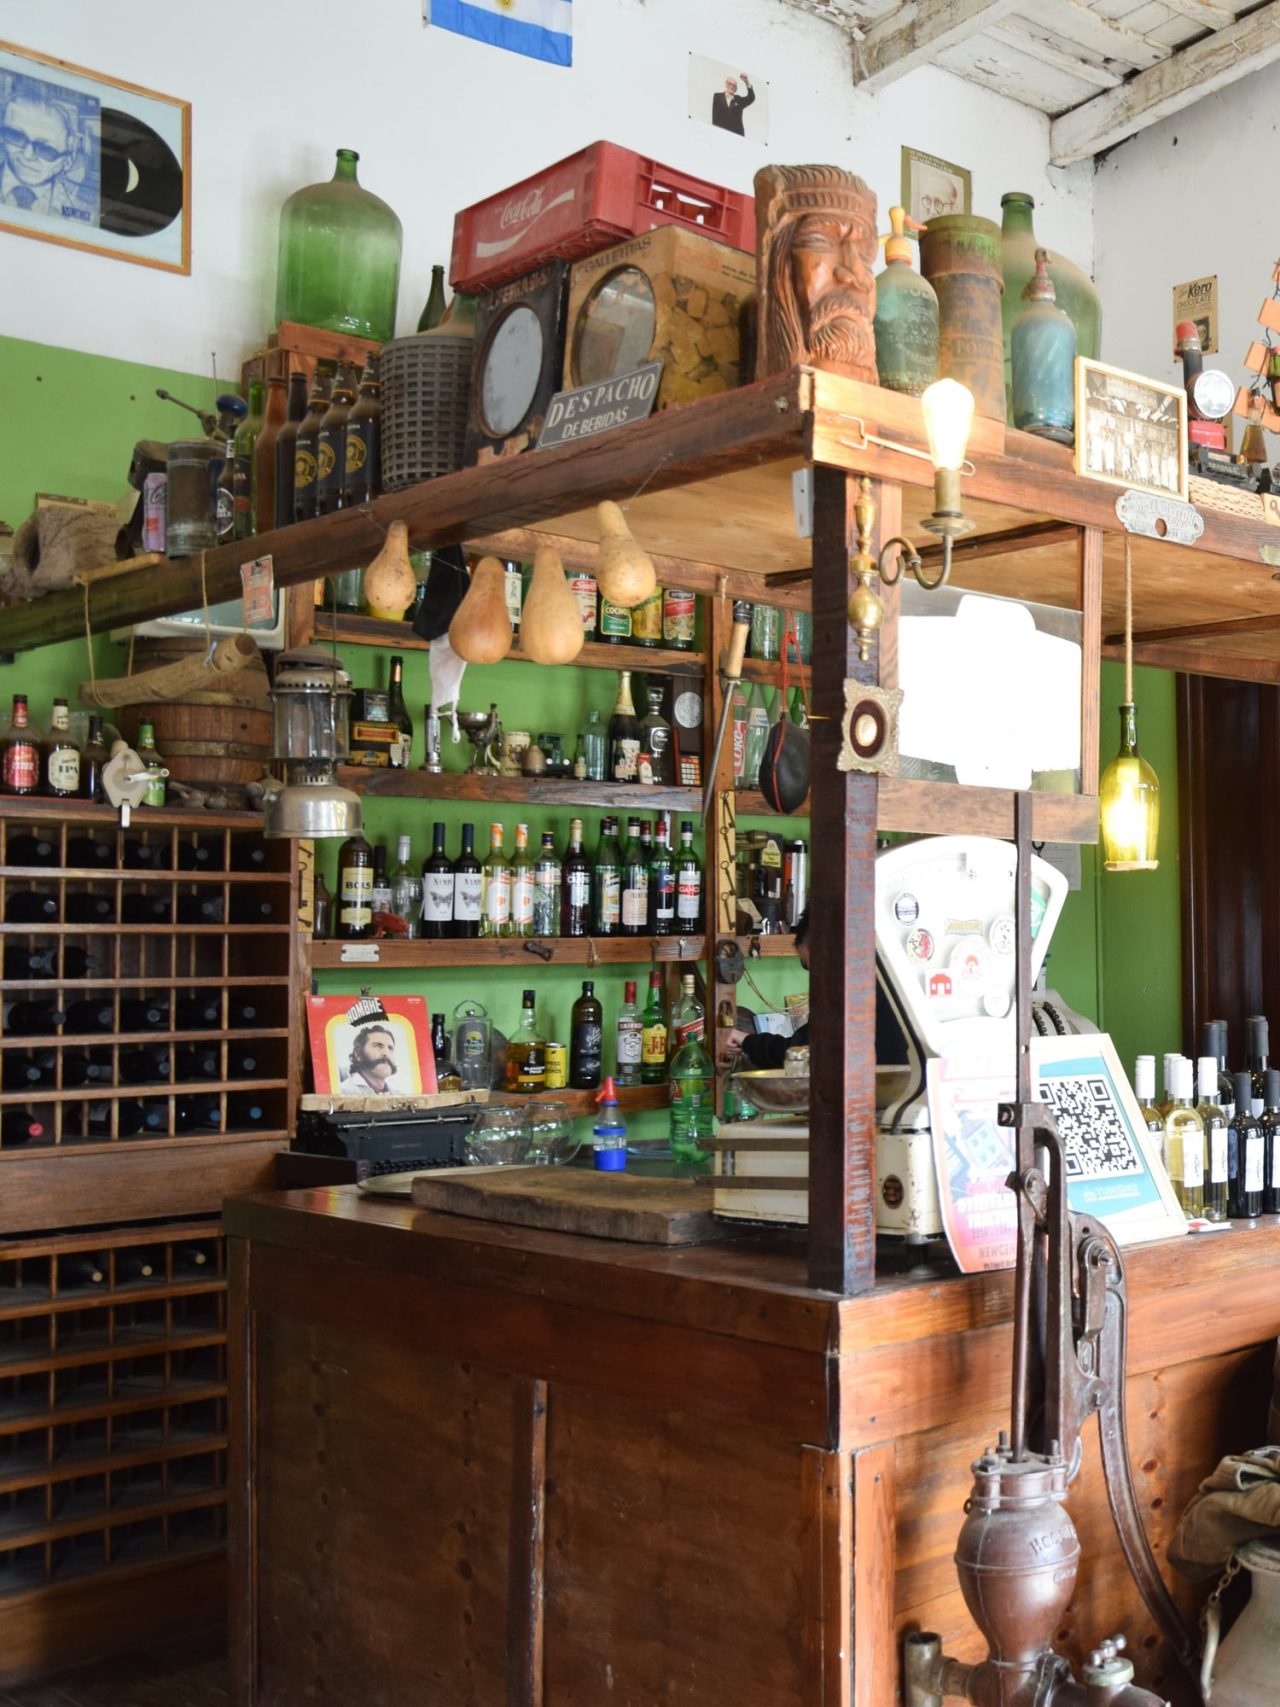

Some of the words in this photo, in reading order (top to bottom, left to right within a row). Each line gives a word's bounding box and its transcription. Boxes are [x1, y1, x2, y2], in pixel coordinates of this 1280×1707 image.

[1188, 282, 1212, 299] Kero
[548, 372, 656, 428] DESPACHO
[562, 423, 579, 439] DE
[580, 407, 628, 435] BEBIDAS
